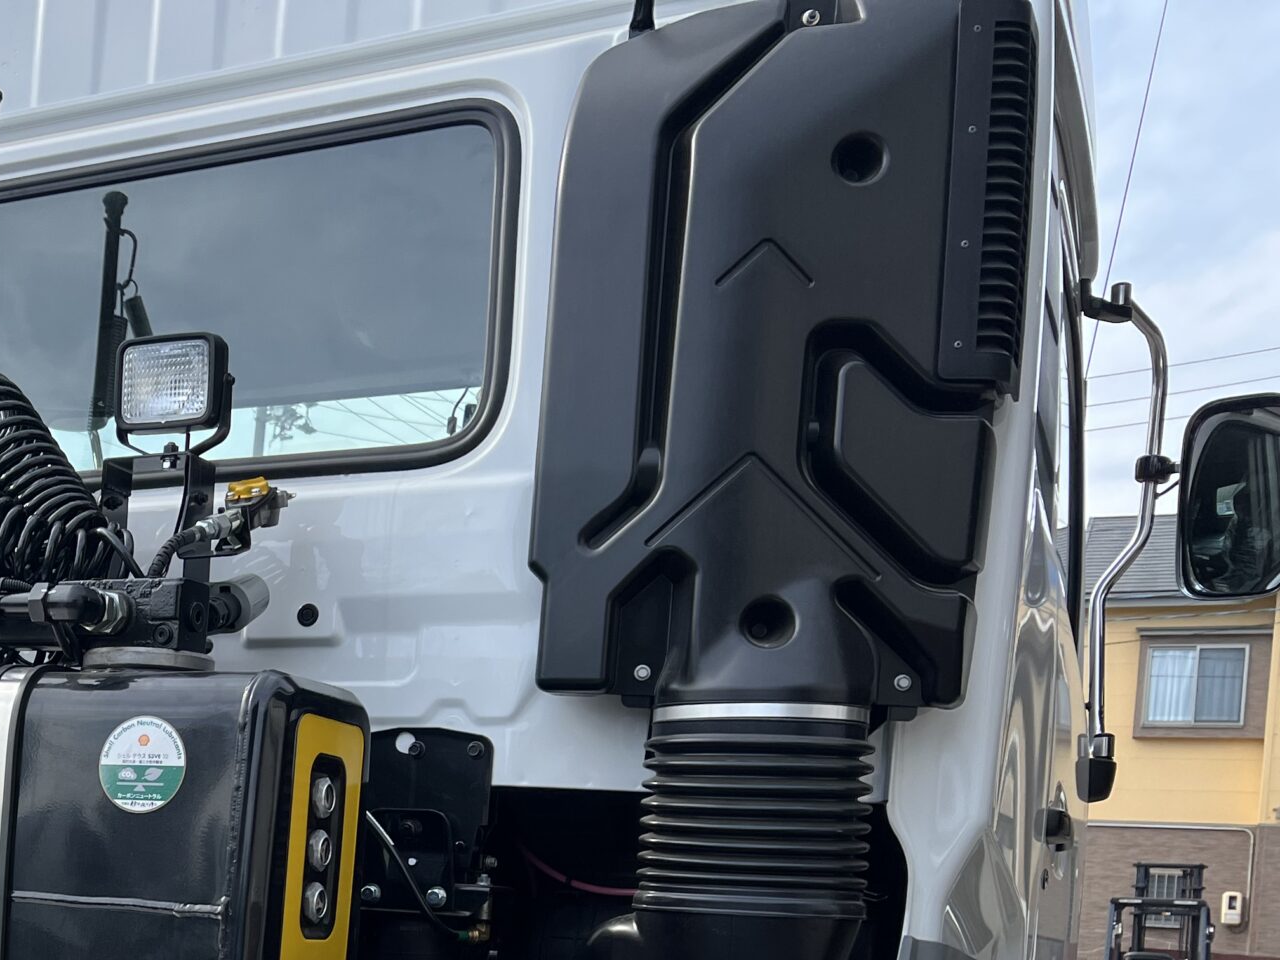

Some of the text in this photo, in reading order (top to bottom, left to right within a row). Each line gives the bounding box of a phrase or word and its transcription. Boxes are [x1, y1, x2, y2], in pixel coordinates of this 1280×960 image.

[113, 723, 136, 740] Carbon
[136, 720, 162, 729] Neutral
[162, 726, 183, 760] Lubricants
